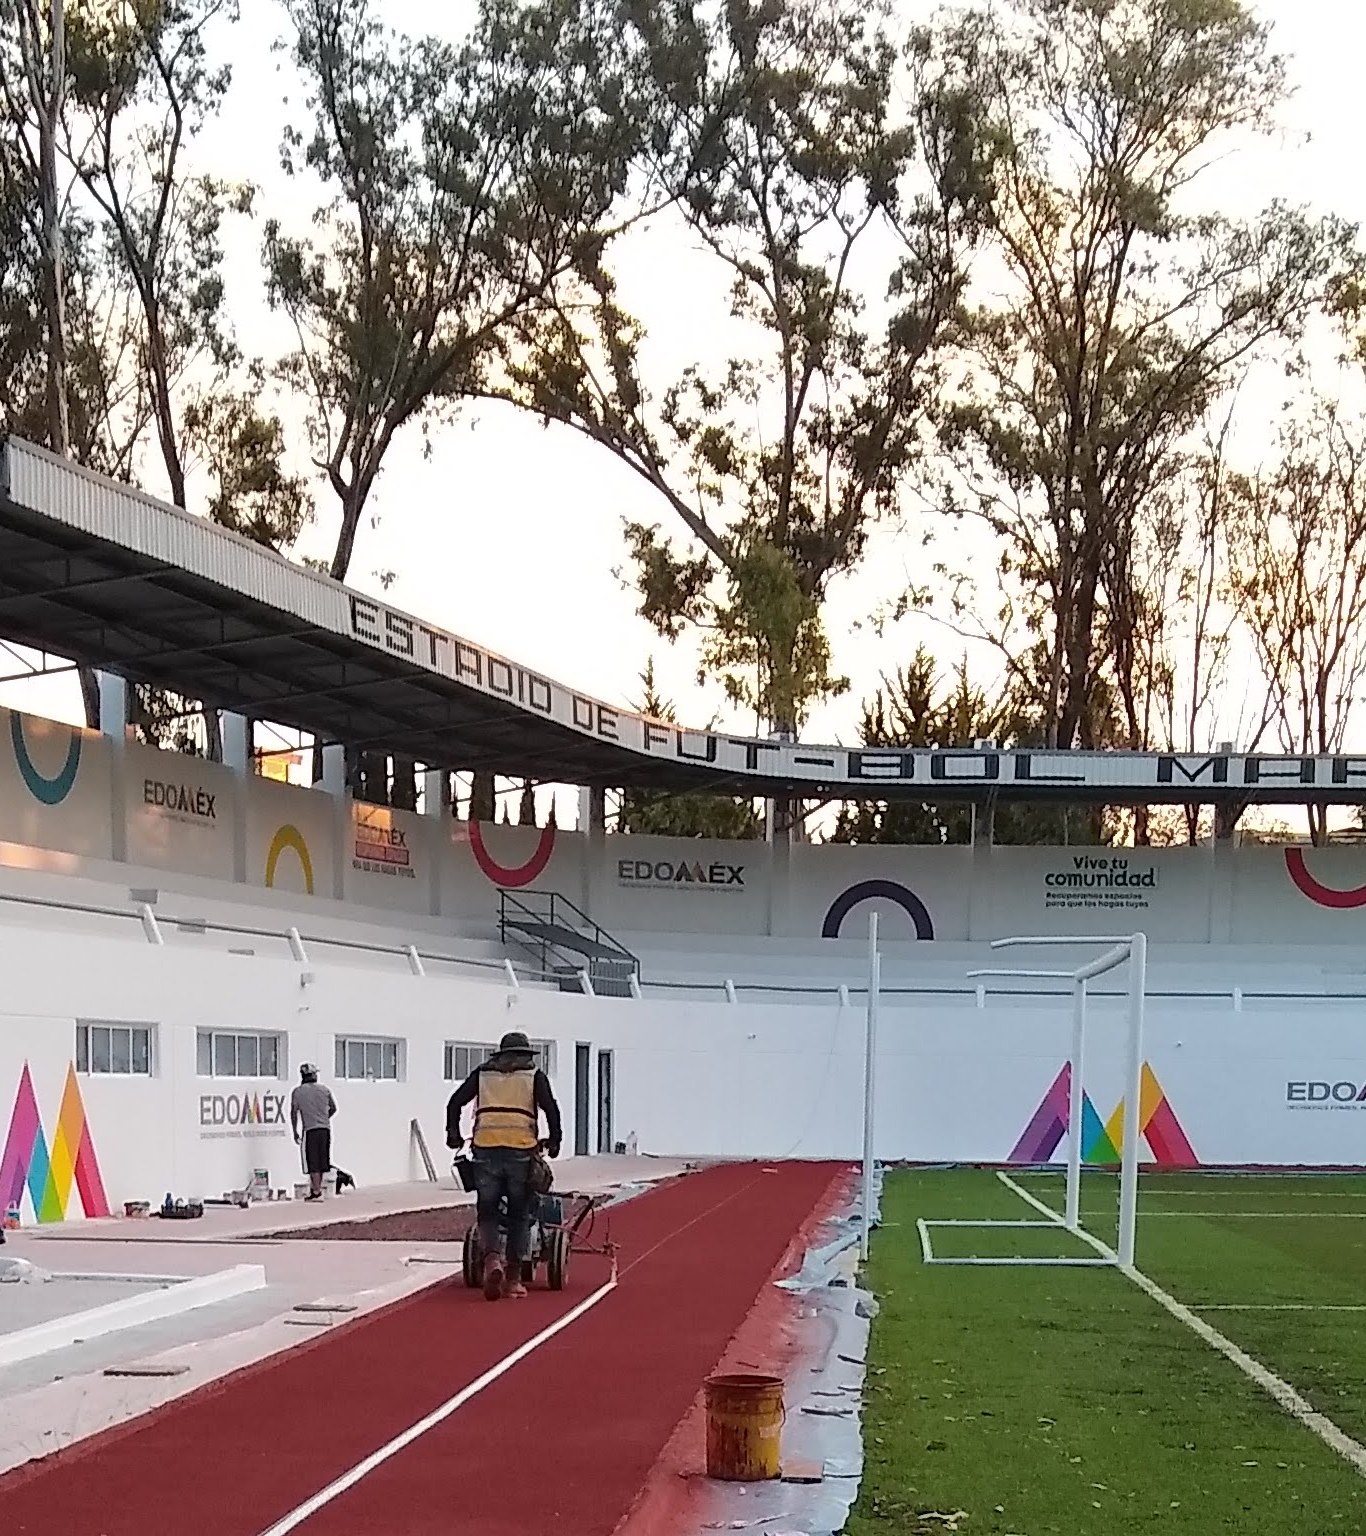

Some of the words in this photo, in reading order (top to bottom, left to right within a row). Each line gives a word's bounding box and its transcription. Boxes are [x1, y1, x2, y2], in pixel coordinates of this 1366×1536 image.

[348, 594, 552, 714] ESTADIO
[572, 694, 620, 741] DE
[144, 779, 216, 819] EDOMÉX
[618, 860, 745, 885] EDOMÉX
[1073, 856, 1109, 869] Vive
[1111, 857, 1129, 869] tu
[1045, 867, 1156, 887] comunidad
[1045, 900, 1066, 908] para
[1098, 900, 1124, 909] hagas
[1046, 891, 1103, 900] Recuperamos
[200, 1090, 286, 1125] EDOMÉX
